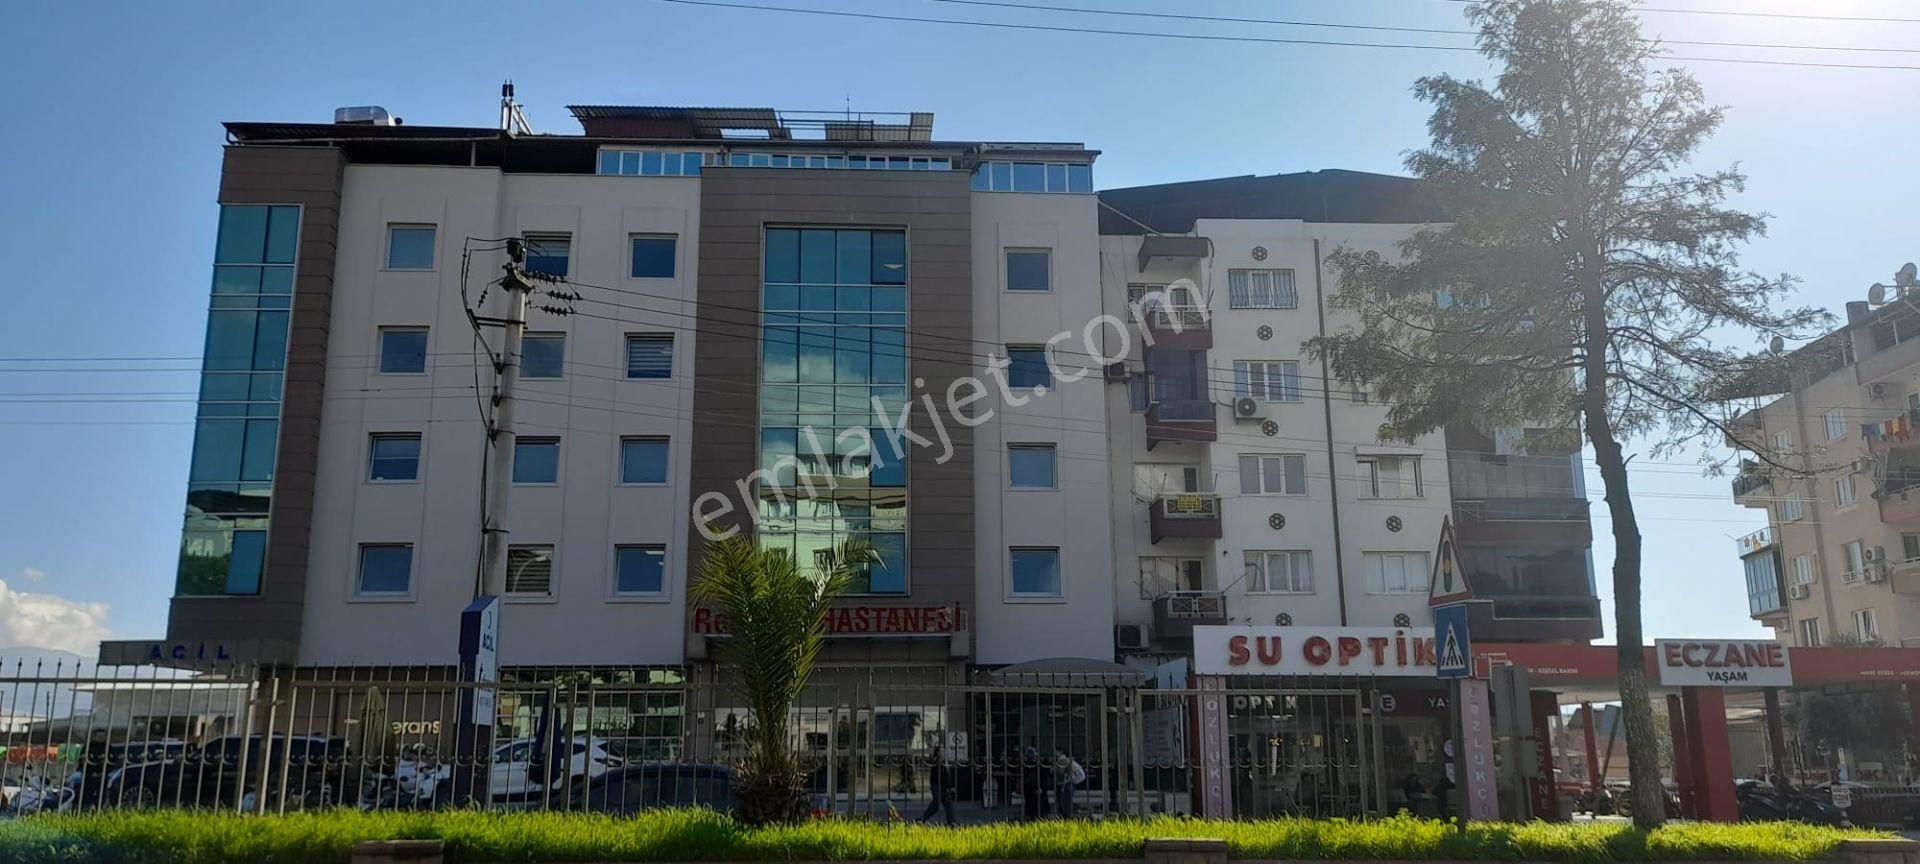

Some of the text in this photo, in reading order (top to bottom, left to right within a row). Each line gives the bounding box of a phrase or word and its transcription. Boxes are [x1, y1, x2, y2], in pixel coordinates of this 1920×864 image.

[151, 641, 229, 660] ACİL
[1228, 630, 1436, 667] SU OPTİK
[1664, 642, 1785, 668] ECZANE
[1706, 671, 1748, 684] YAŞAM
